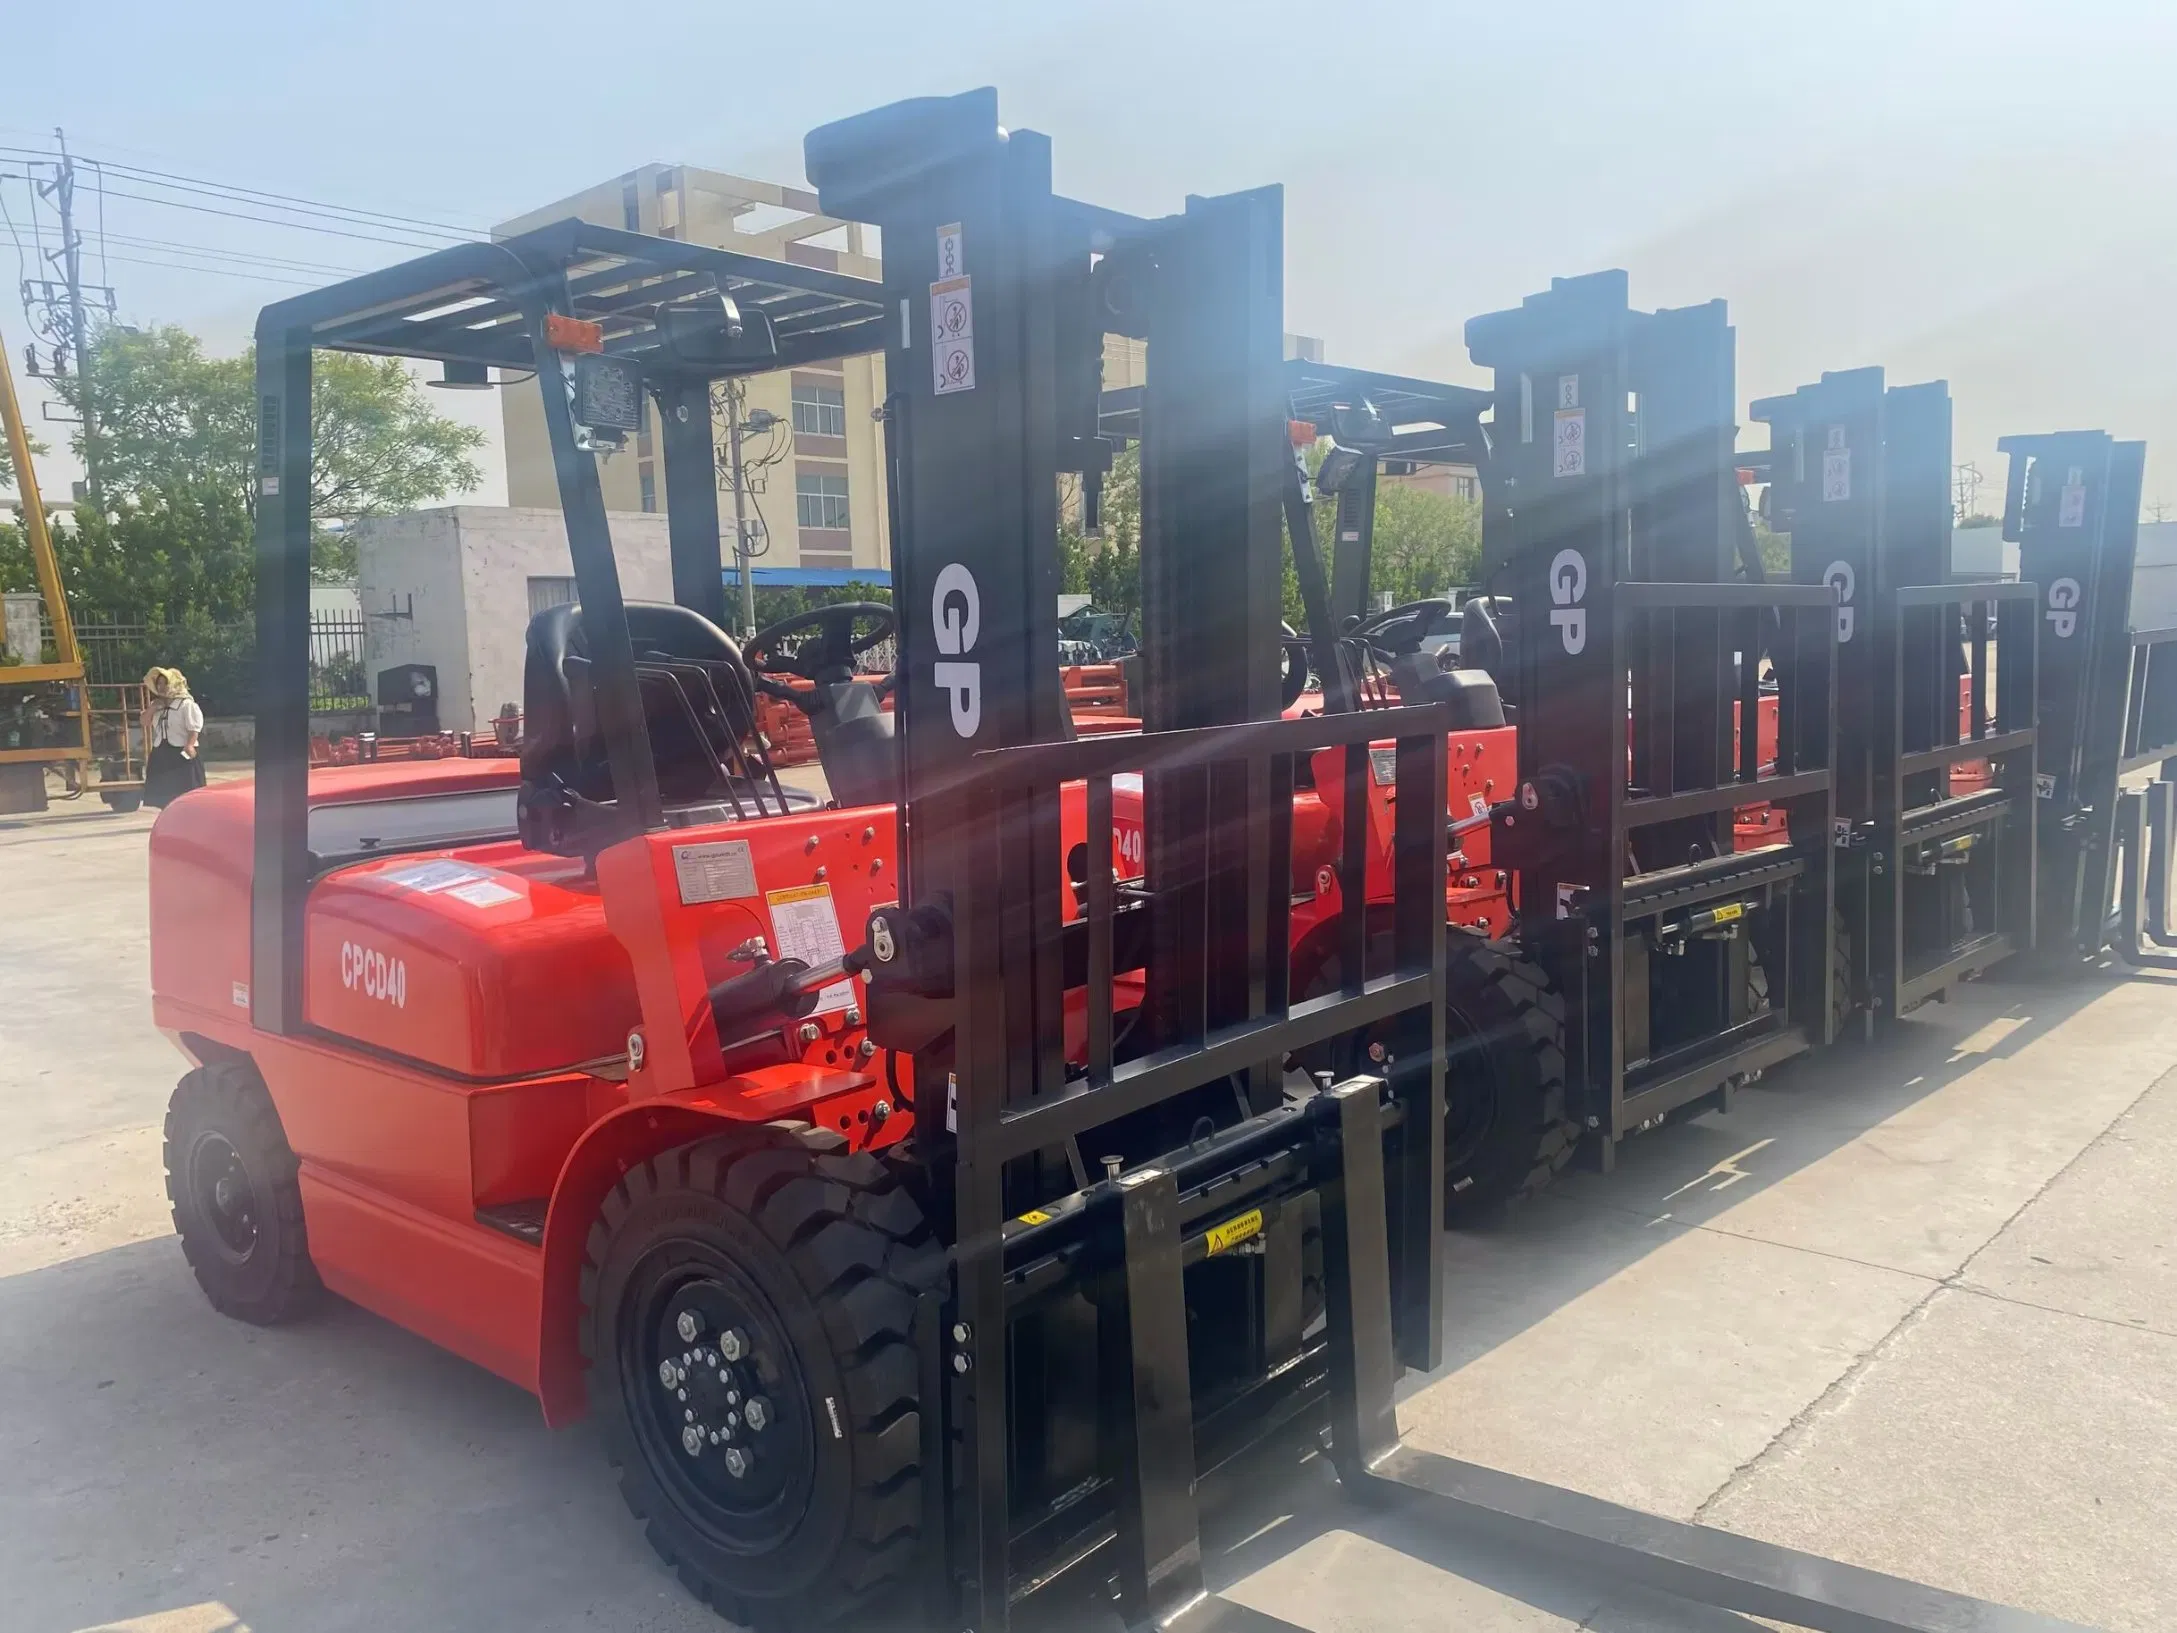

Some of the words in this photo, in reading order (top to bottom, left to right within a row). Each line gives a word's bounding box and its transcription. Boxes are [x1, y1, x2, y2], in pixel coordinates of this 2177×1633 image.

[1550, 549, 1586, 655] GP
[1823, 560, 1855, 642] GP
[2045, 577, 2080, 637] GP
[932, 563, 981, 738] GP
[341, 940, 406, 1008] CPCD40
